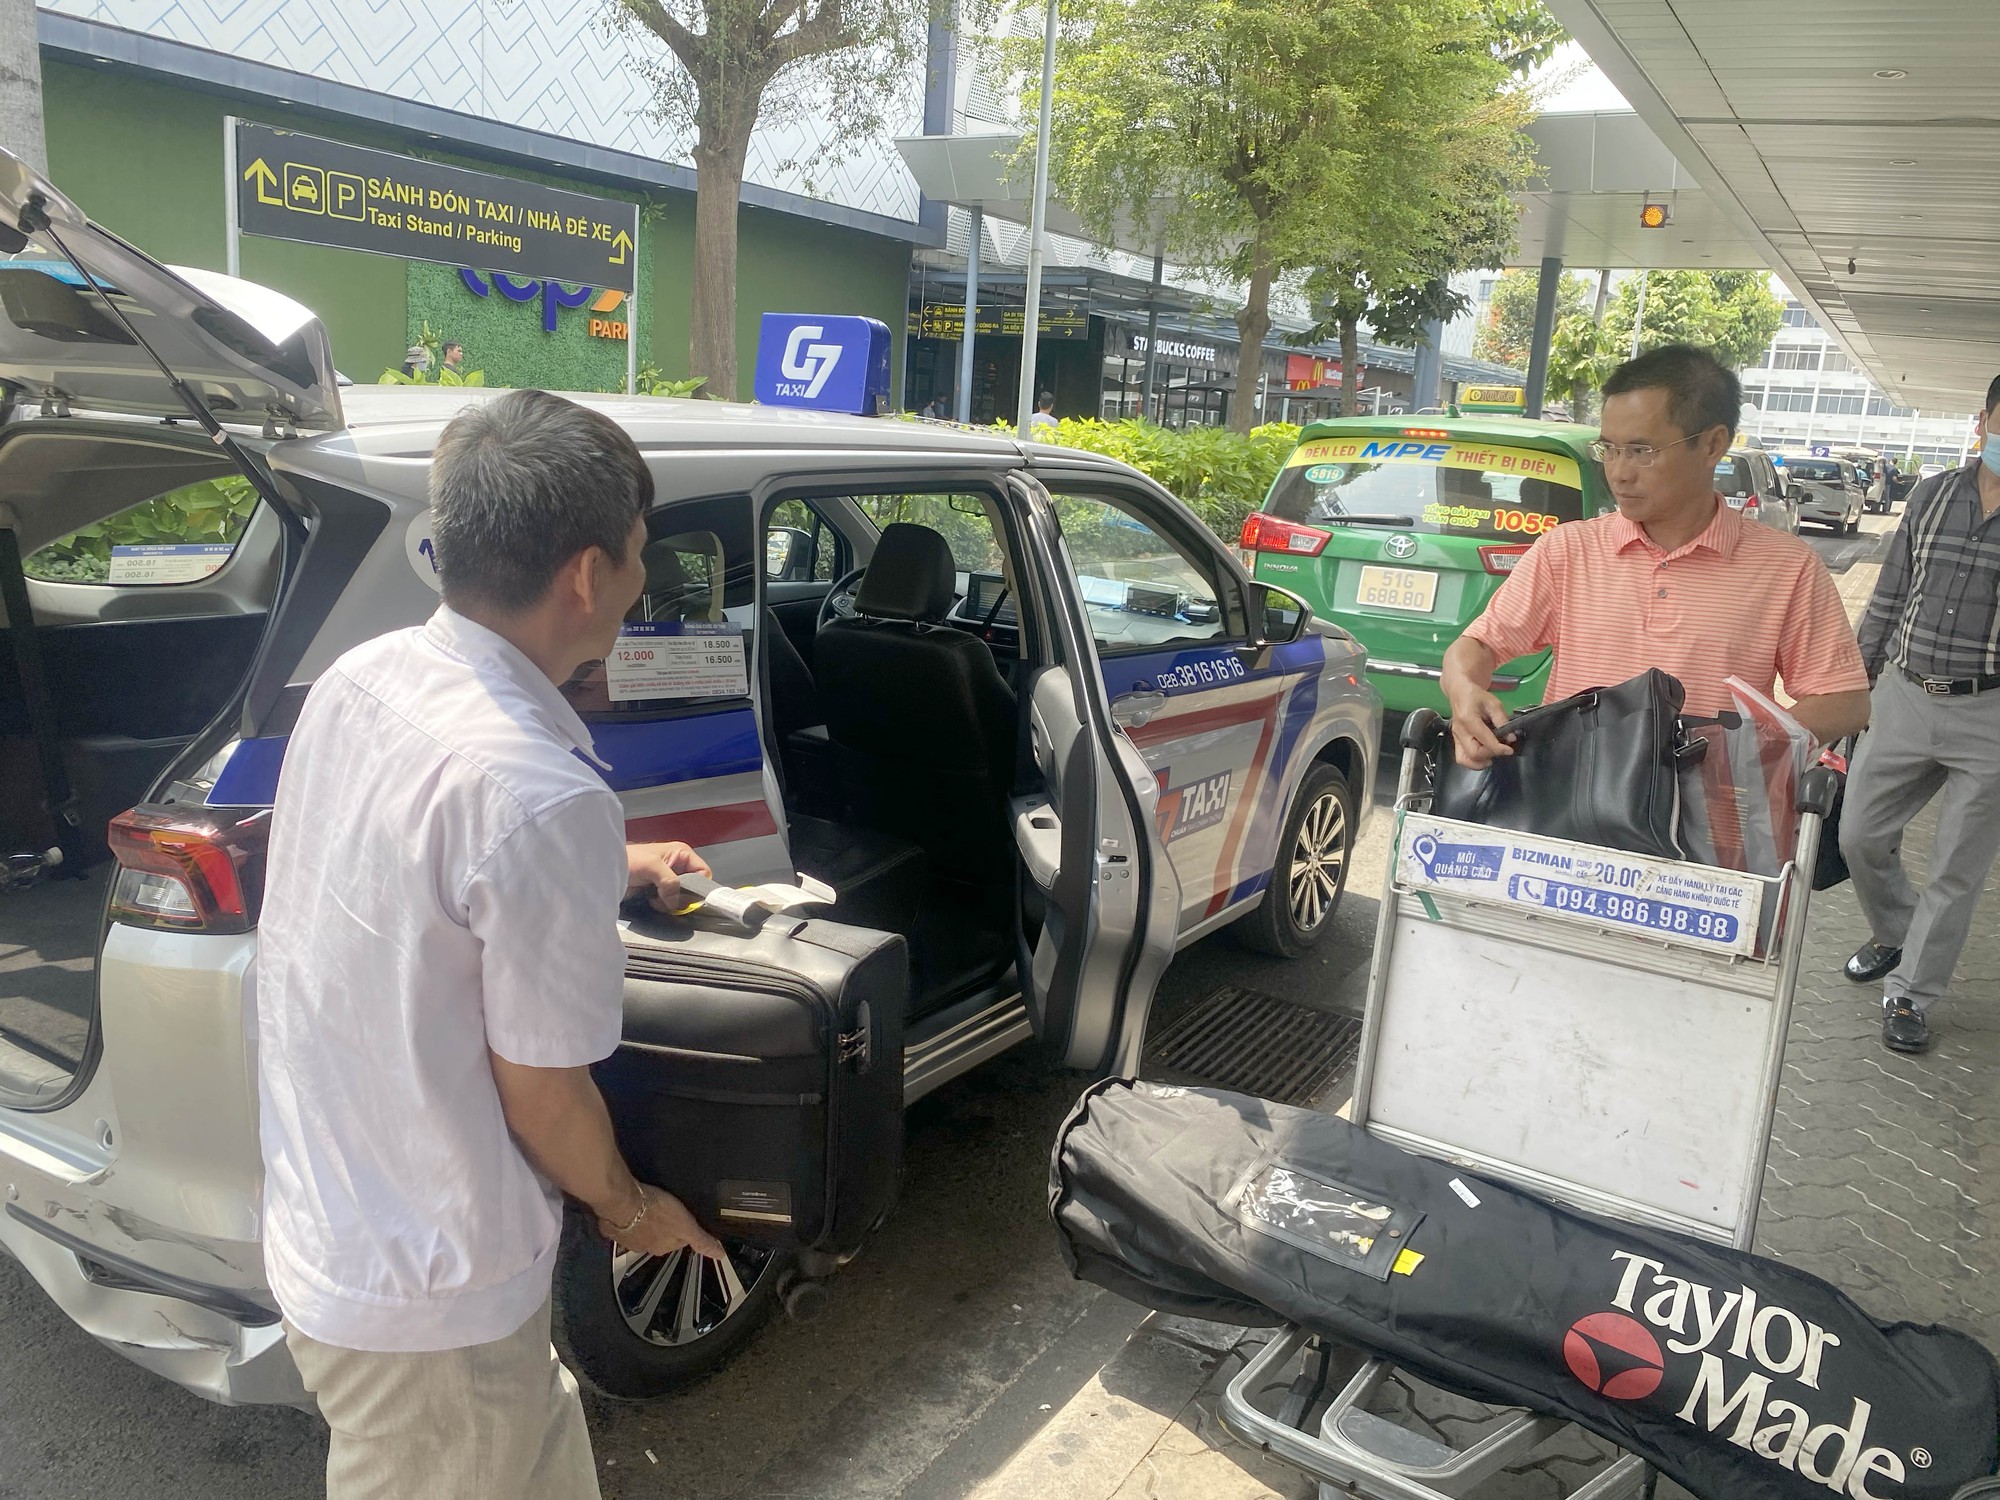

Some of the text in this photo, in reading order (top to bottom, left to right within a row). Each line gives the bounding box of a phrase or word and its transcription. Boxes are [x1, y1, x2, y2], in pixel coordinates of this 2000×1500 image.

[367, 176, 424, 207] SẢNH
[428, 189, 470, 216] ĐÓN
[475, 199, 514, 224] TAXI
[518, 207, 524, 225] /
[527, 210, 563, 233] NHÀ
[591, 222, 612, 242] XE
[368, 207, 522, 253] Taxi Stand / Parking
[781, 325, 843, 399] G7
[1185, 345, 1216, 362] COFFEE
[775, 383, 805, 397] TAXI
[1480, 390, 1517, 403] 1055
[1332, 445, 1357, 457] LED
[1360, 442, 1452, 461] MPE
[1456, 450, 1498, 466] THIẾT
[1501, 456, 1518, 471] BỊ
[1520, 458, 1557, 475] ĐIỆN
[1311, 468, 1339, 480] 5819
[1469, 509, 1491, 520] TAXI
[1495, 509, 1560, 535] 1055
[1263, 562, 1299, 573] INNOVA
[1382, 570, 1415, 589] 51G
[1366, 587, 1425, 607] 688.80
[703, 641, 731, 649] 18.500
[617, 650, 655, 661] 12.000
[705, 655, 733, 664] 16.500
[1182, 774, 1231, 823] TAXI
[1456, 850, 1477, 864] MỜI
[1512, 847, 1572, 870] BIZMAN
[1576, 859, 1593, 869] CUNG
[1434, 861, 1469, 877] QUẢNG
[1658, 874, 1668, 884] XE
[1716, 885, 1727, 896] TẠI
[1655, 884, 1740, 909] CẢNG HÀNG KHÔNG QUỐC TẾ
[1555, 886, 1728, 939] 094.986.98.98
[1610, 1249, 1842, 1391] Taylor
